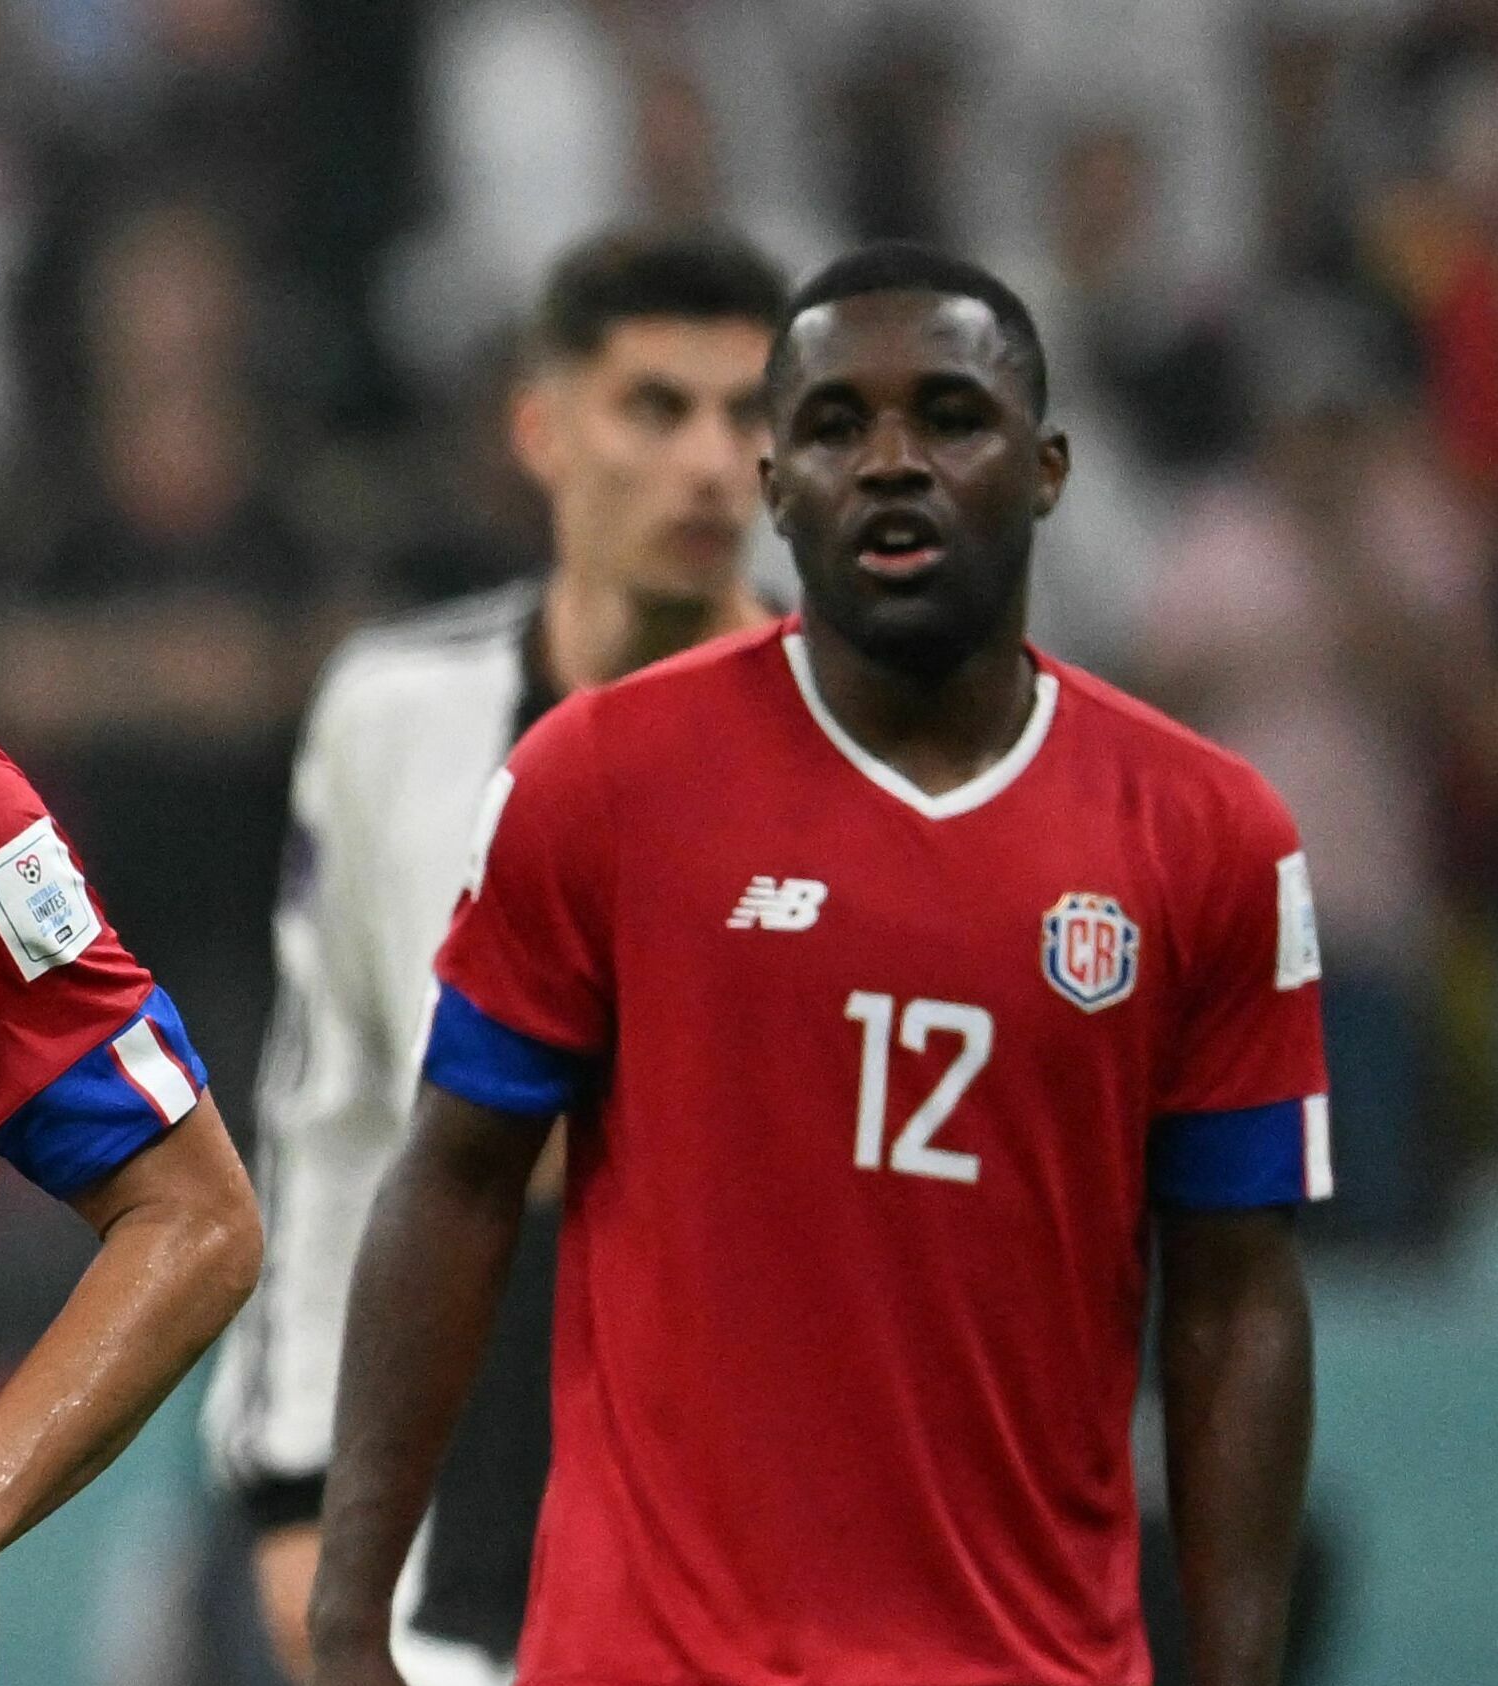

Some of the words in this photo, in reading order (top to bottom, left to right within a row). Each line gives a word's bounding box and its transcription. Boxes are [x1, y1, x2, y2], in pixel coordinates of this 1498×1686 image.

[32, 890, 67, 923] UNITES
[1066, 918, 1116, 987] CR
[844, 989, 994, 1184] 12
